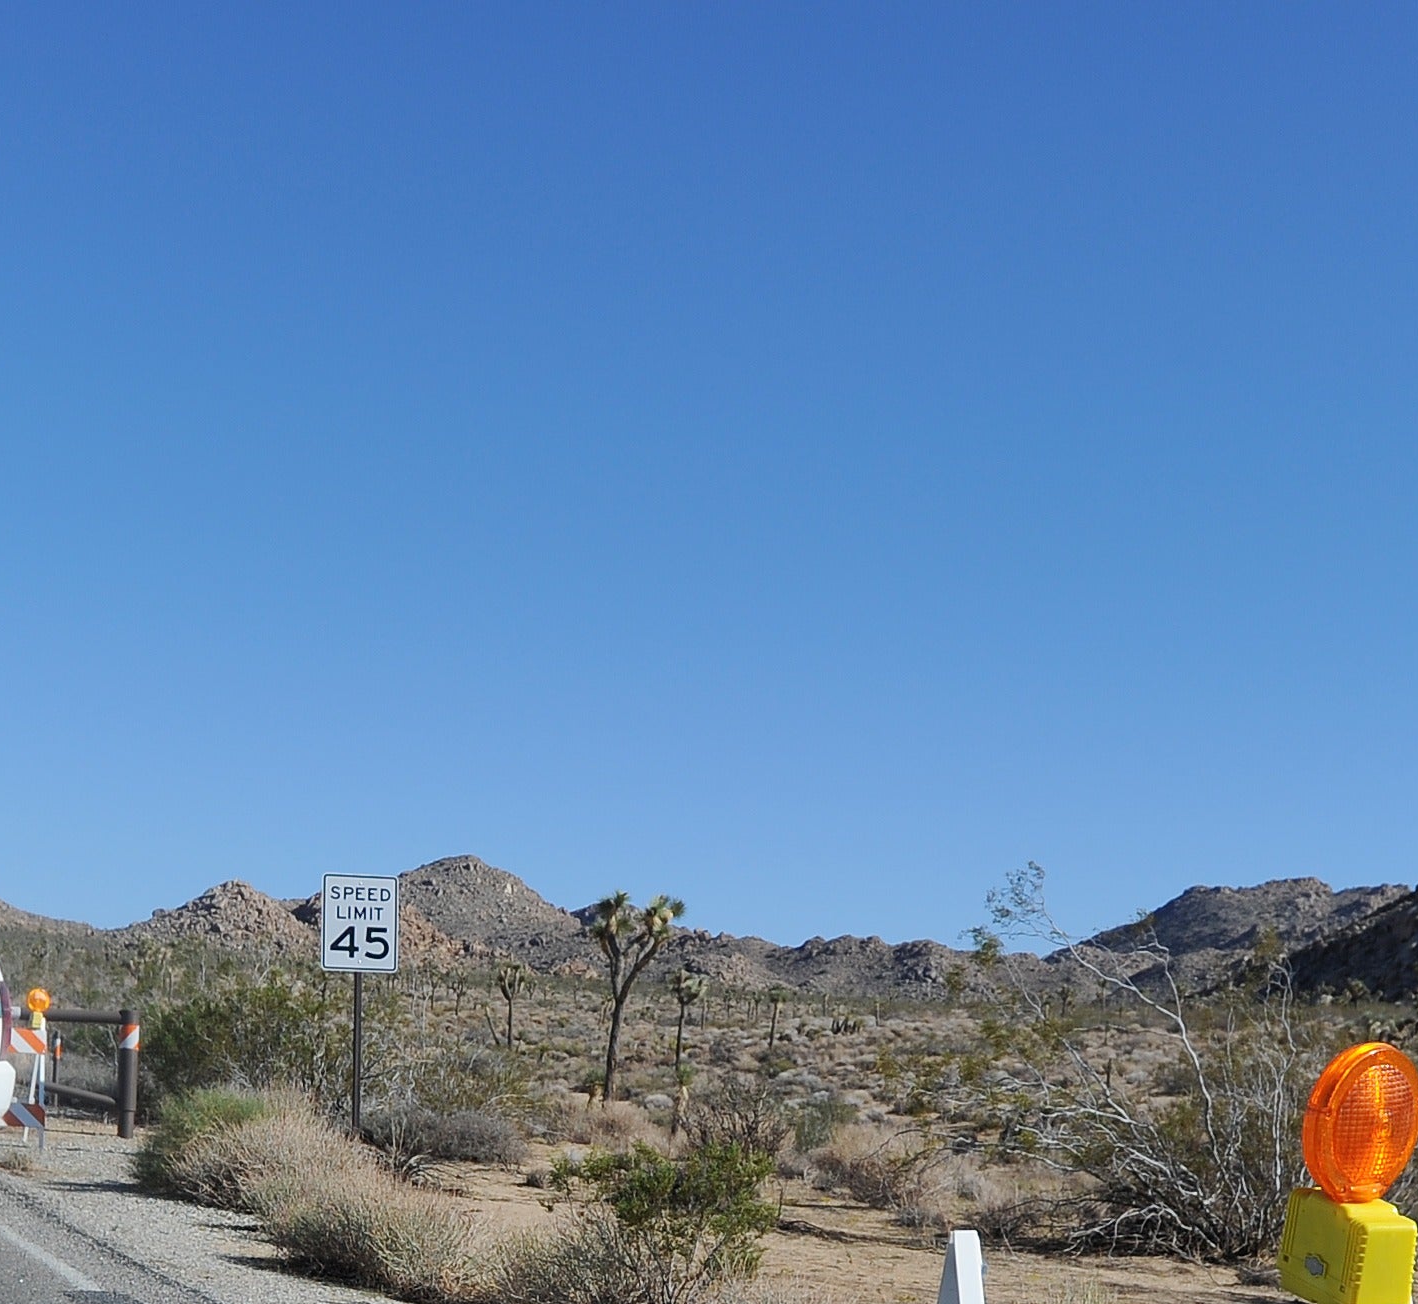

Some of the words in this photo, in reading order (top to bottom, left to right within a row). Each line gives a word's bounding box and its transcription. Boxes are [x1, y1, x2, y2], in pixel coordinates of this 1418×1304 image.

[330, 885, 391, 902] SPEED
[336, 905, 384, 921] LIMIT
[329, 926, 390, 960] 45
